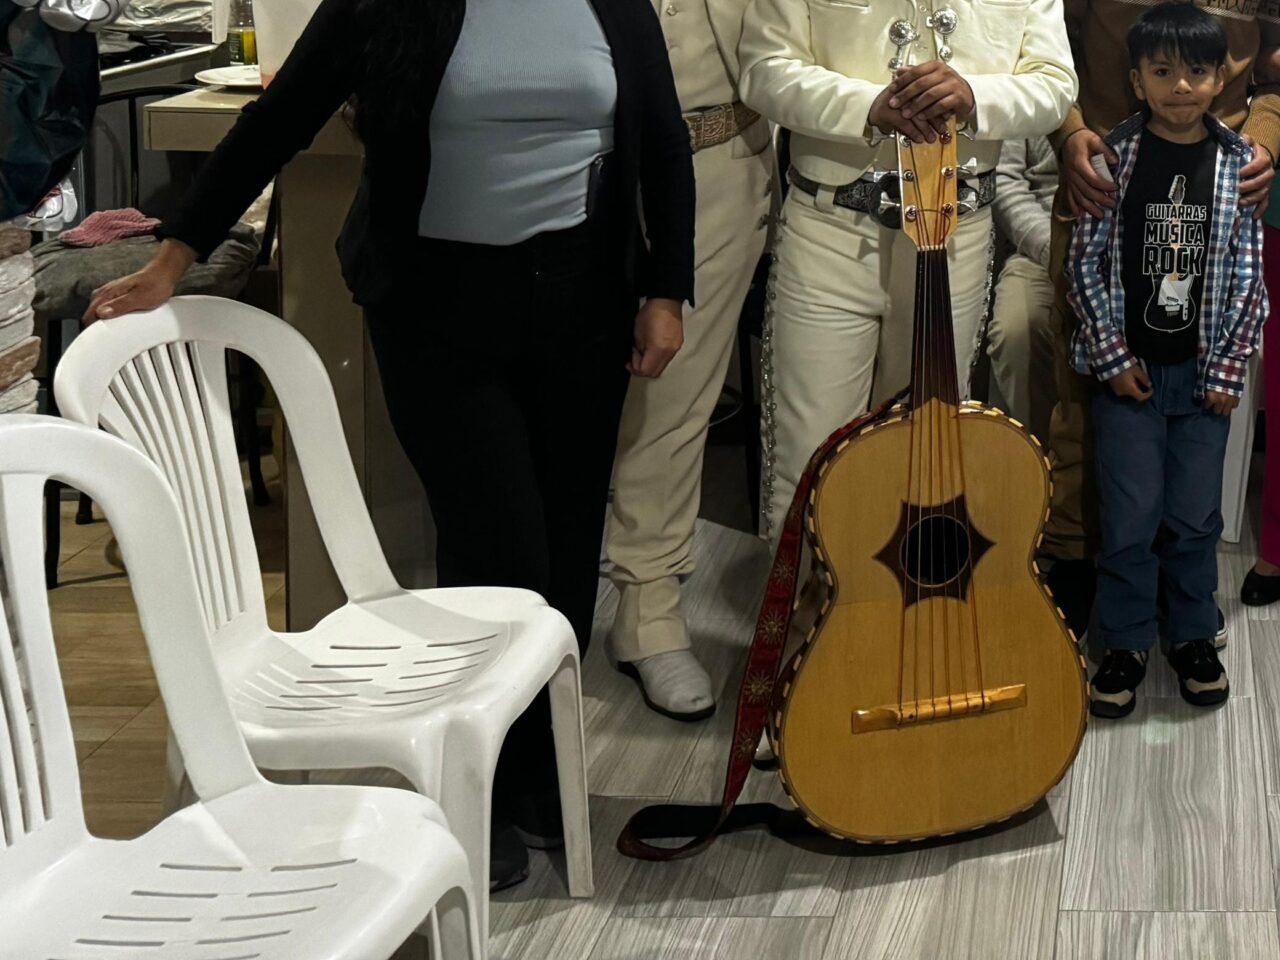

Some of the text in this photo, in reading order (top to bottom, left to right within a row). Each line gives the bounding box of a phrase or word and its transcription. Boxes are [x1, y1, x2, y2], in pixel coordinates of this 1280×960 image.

[1145, 203, 1207, 222] GUITARRAS
[1144, 219, 1205, 246] MÚSICA
[1142, 245, 1205, 276] ROCK
